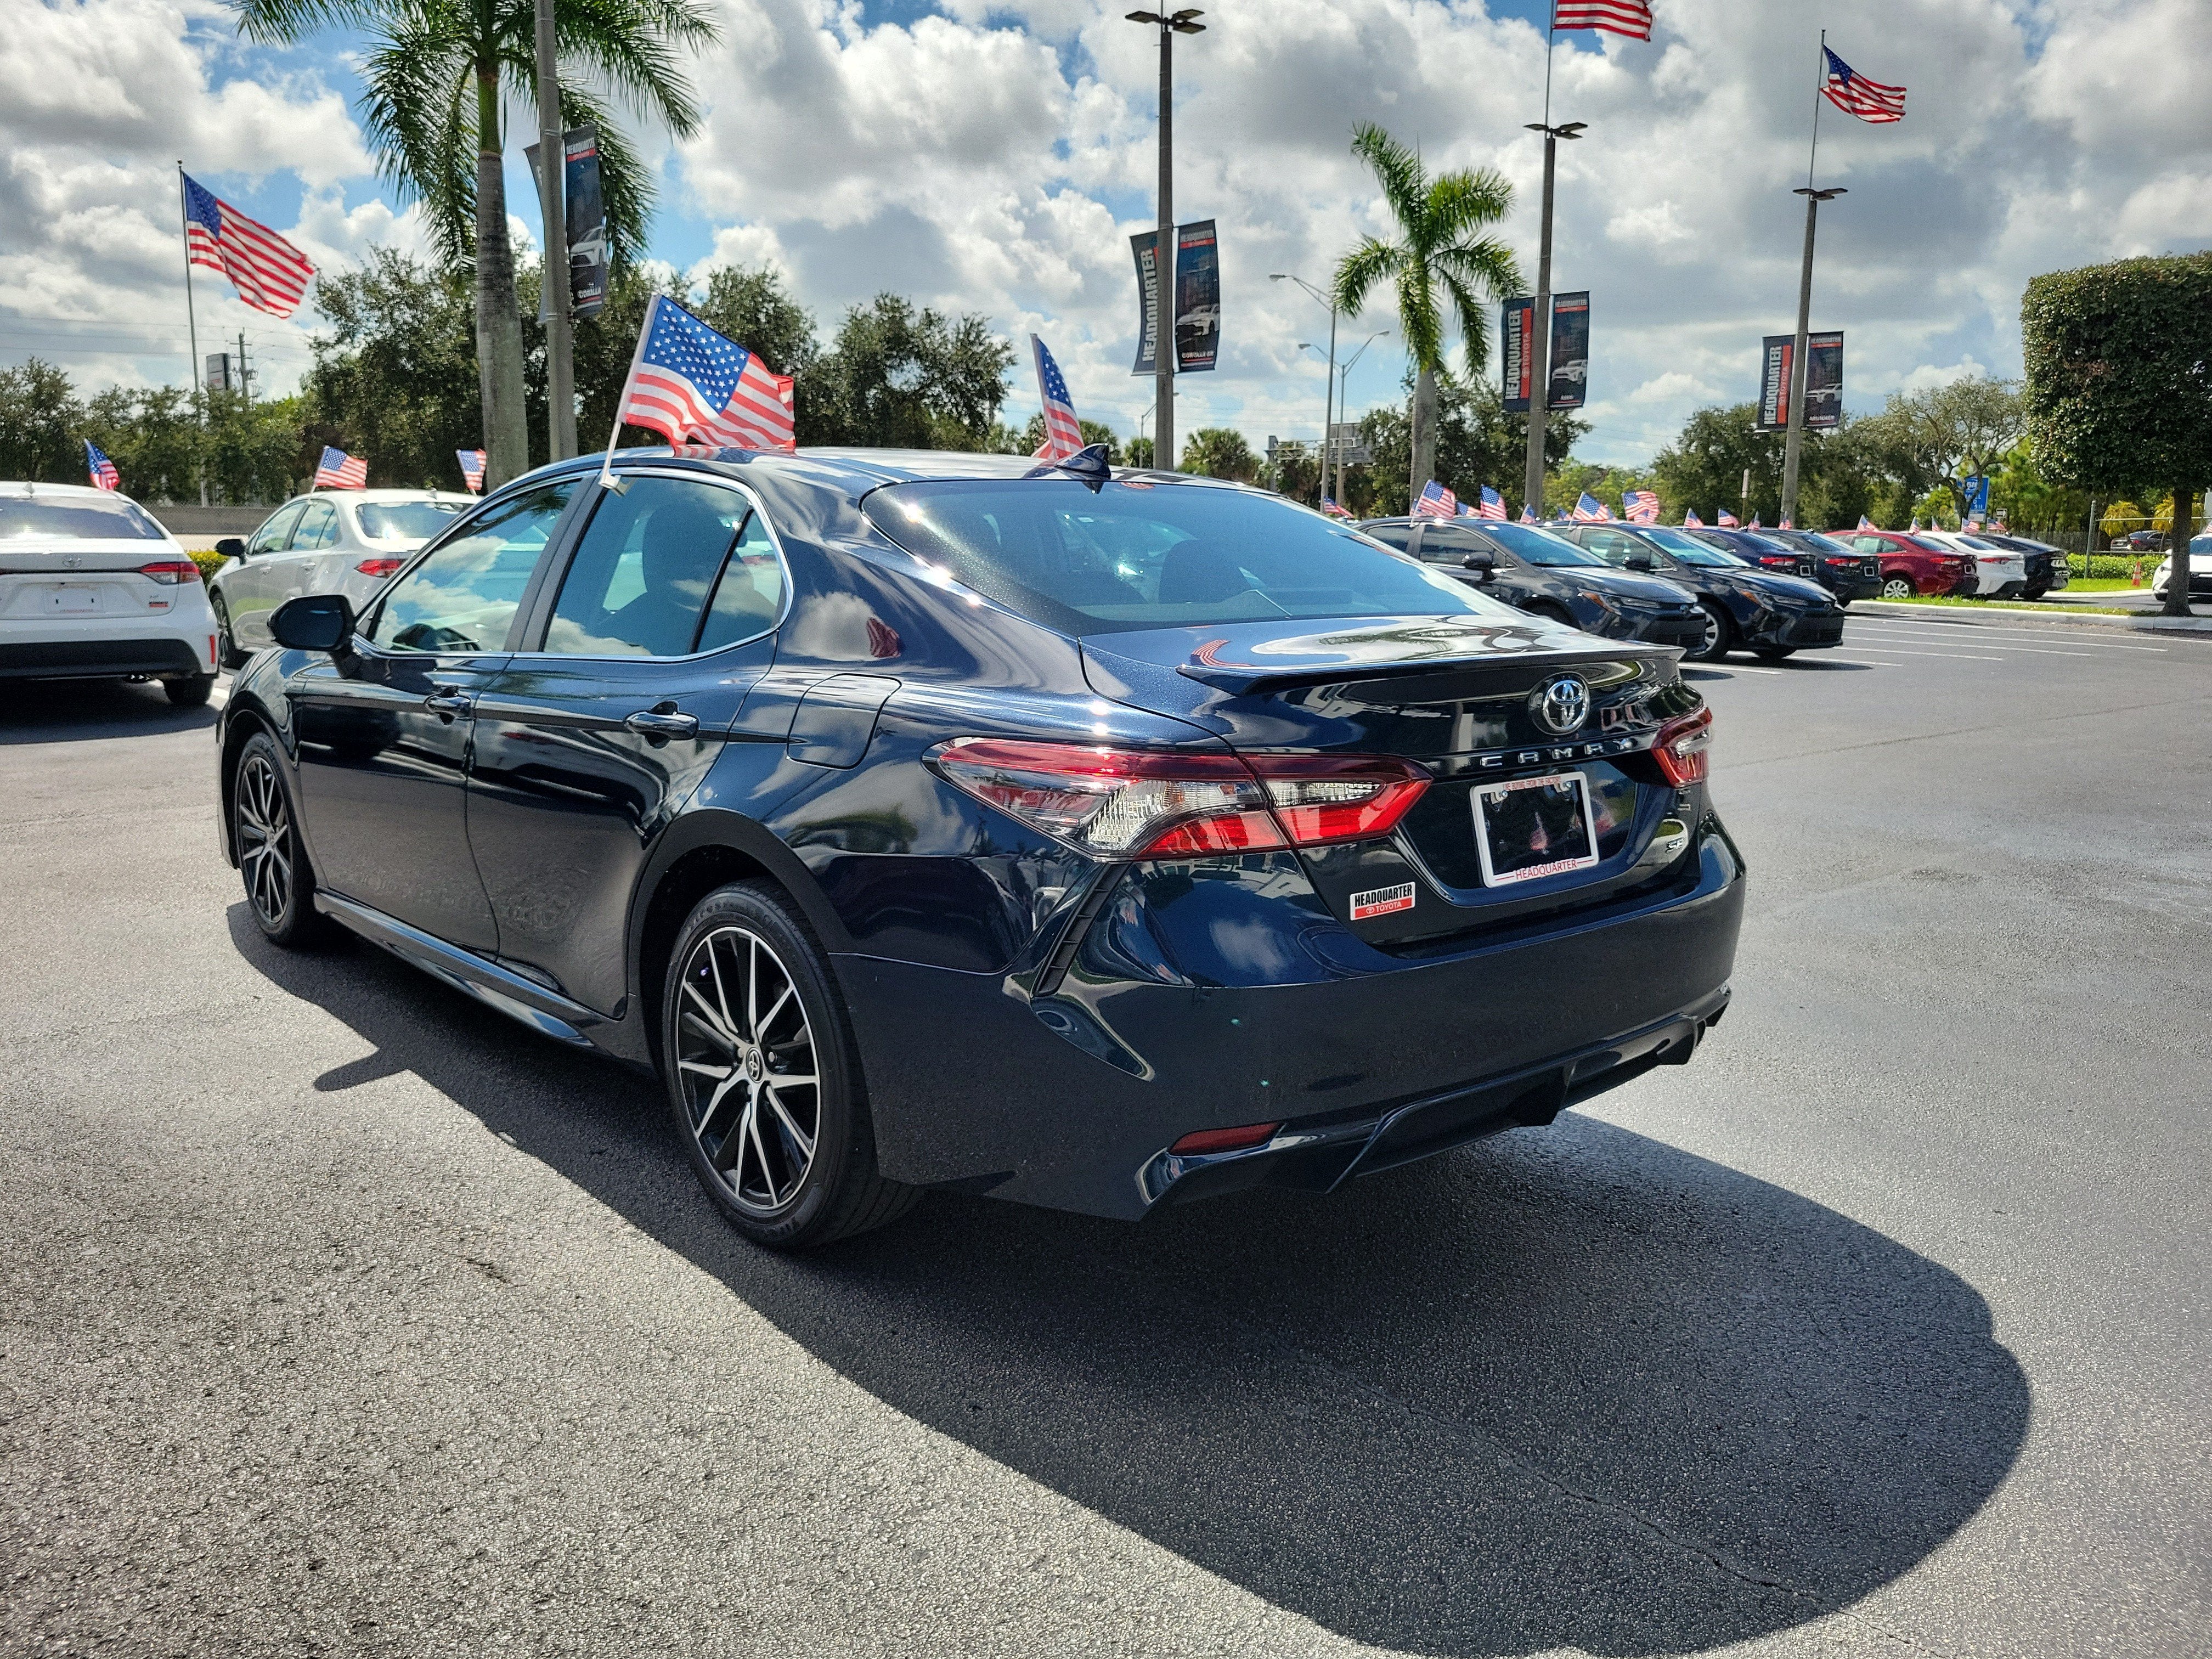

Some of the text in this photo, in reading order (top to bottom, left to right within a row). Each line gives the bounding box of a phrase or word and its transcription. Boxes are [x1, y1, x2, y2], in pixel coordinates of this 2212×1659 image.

[1141, 248, 1158, 362] HEADQUARTER
[1505, 309, 1521, 399] HEADQUARTER
[1764, 346, 1781, 425] HEADQUARTER
[1480, 738, 1635, 767] CAMRY
[1515, 859, 1577, 879] HEADQUARTER
[1355, 884, 1412, 907] HEADQUARTER
[1375, 901, 1402, 912] TOYOTA
